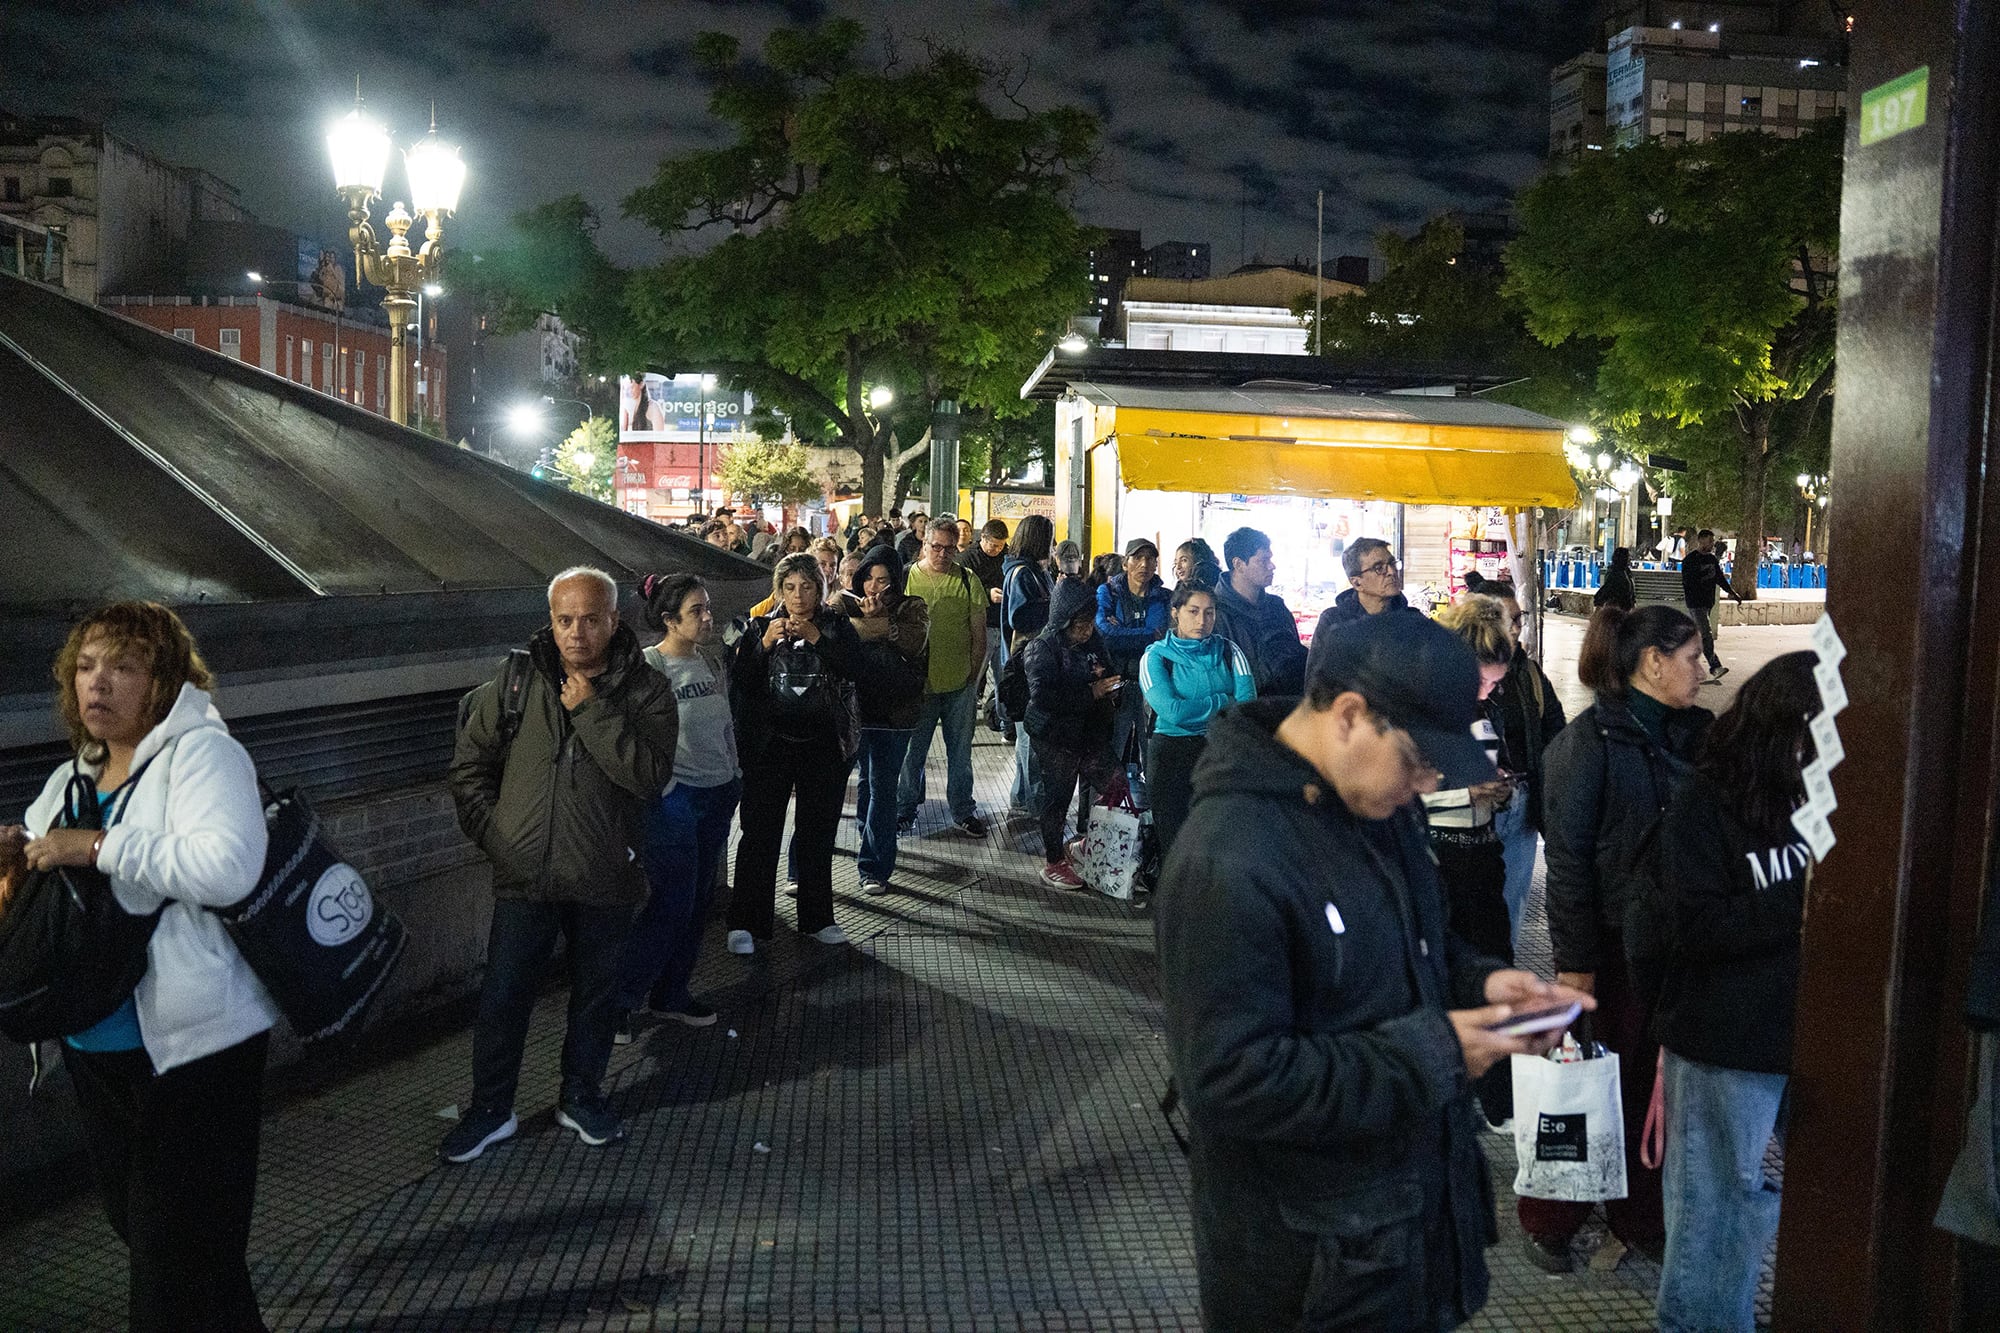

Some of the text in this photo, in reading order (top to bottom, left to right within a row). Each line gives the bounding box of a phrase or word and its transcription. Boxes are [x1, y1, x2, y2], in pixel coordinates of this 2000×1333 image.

[1870, 89, 1917, 137] 197
[664, 400, 739, 418] prepago
[1540, 1118, 1567, 1133] E:e
